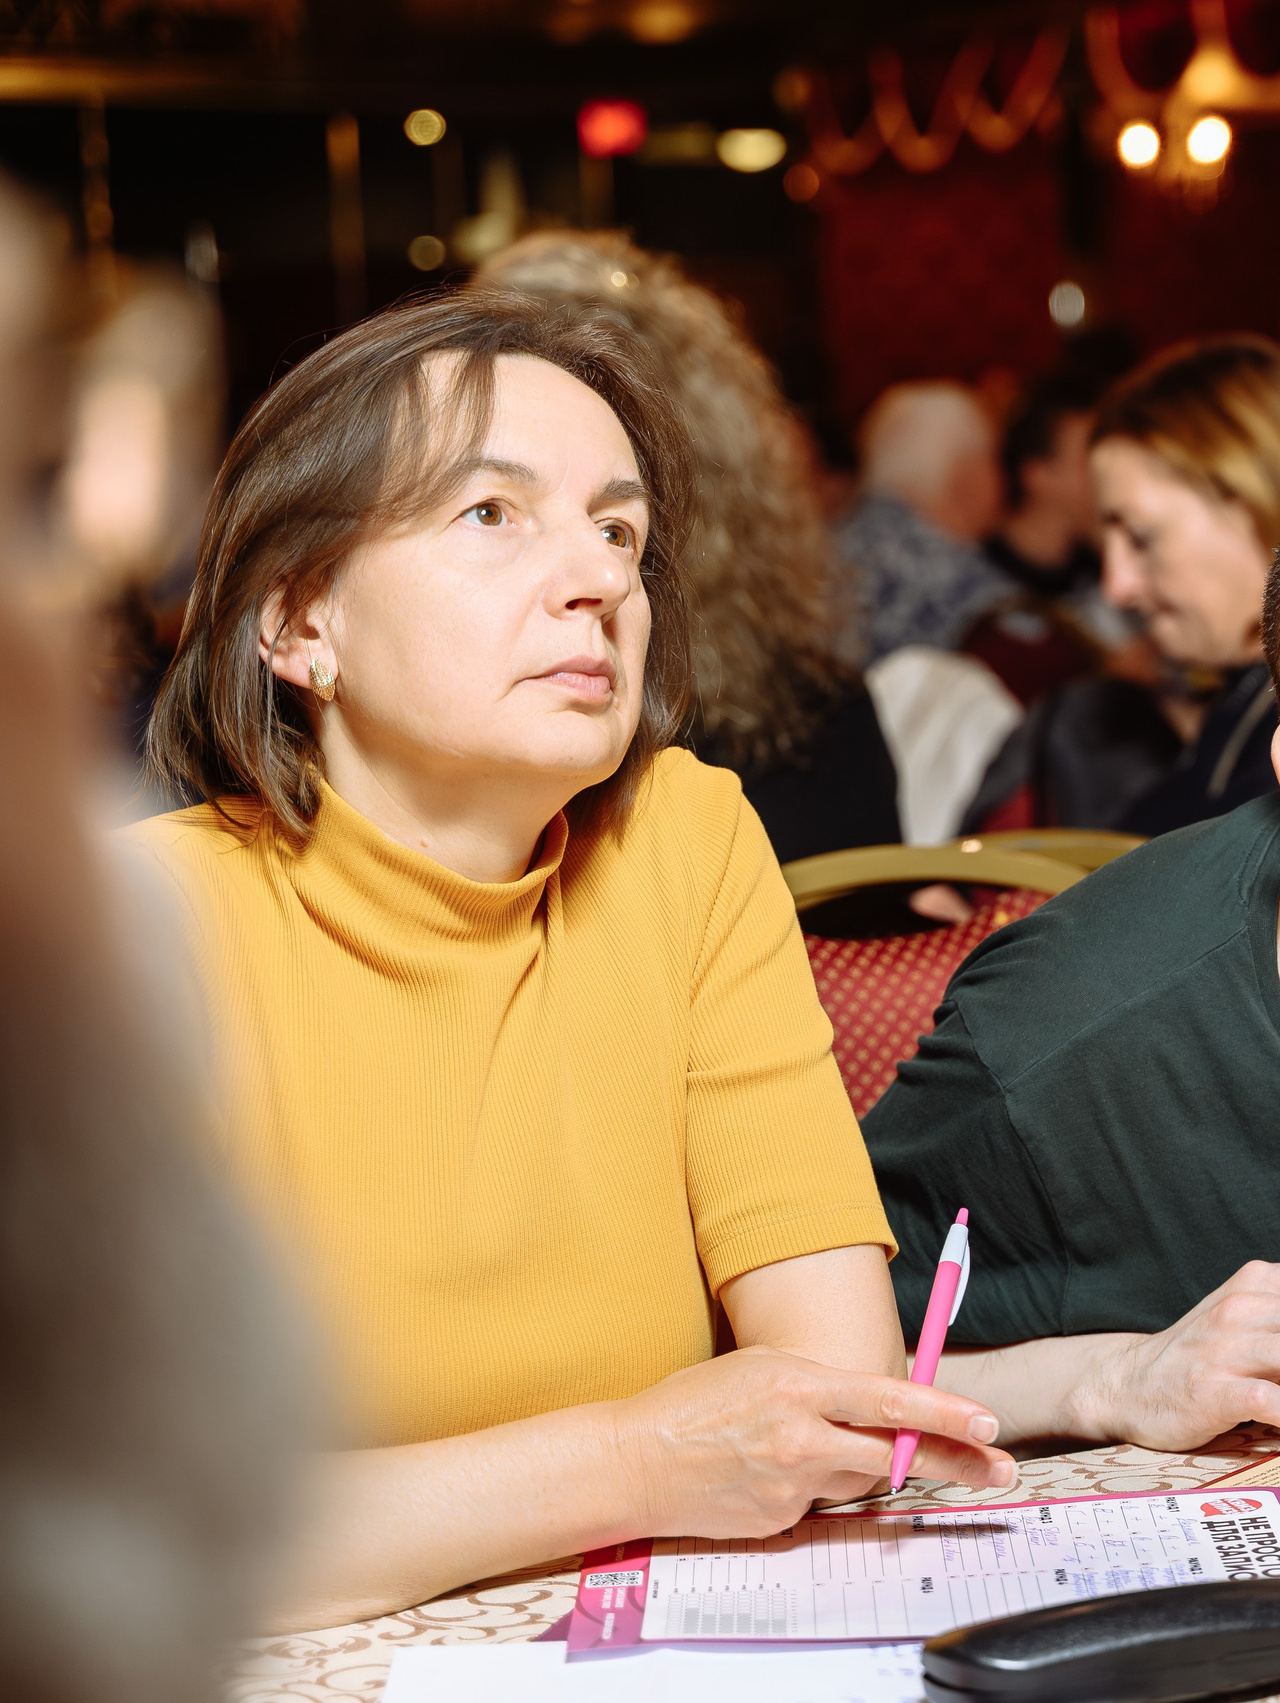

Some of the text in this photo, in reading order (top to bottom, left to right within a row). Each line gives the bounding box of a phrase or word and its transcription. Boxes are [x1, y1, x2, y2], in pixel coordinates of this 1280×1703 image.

[1238, 1516, 1271, 1531] НЕ
[1200, 1520, 1258, 1583] ДЛЯ ЗАПИС
